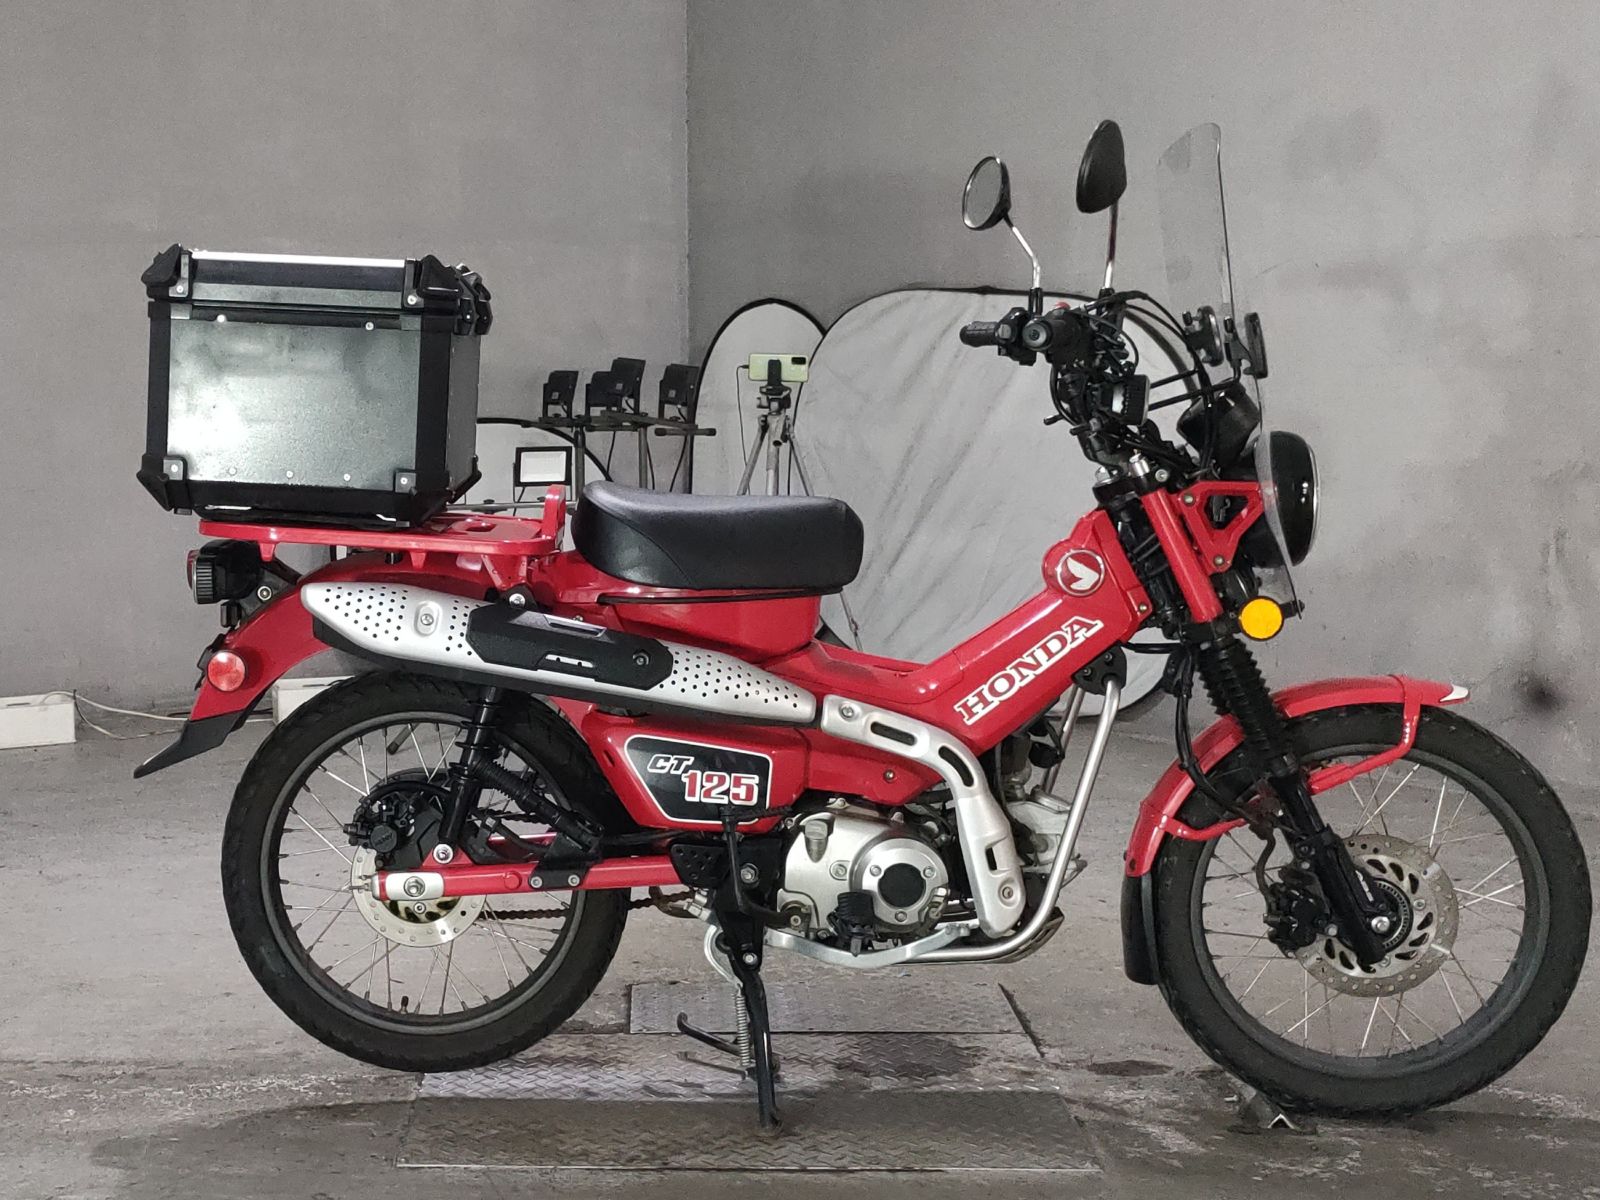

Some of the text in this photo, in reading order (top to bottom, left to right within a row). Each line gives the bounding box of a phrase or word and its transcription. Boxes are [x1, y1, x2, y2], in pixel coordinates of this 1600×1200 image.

[953, 615, 1104, 725] HONDA
[647, 753, 694, 775] CT
[681, 770, 759, 806] 125
